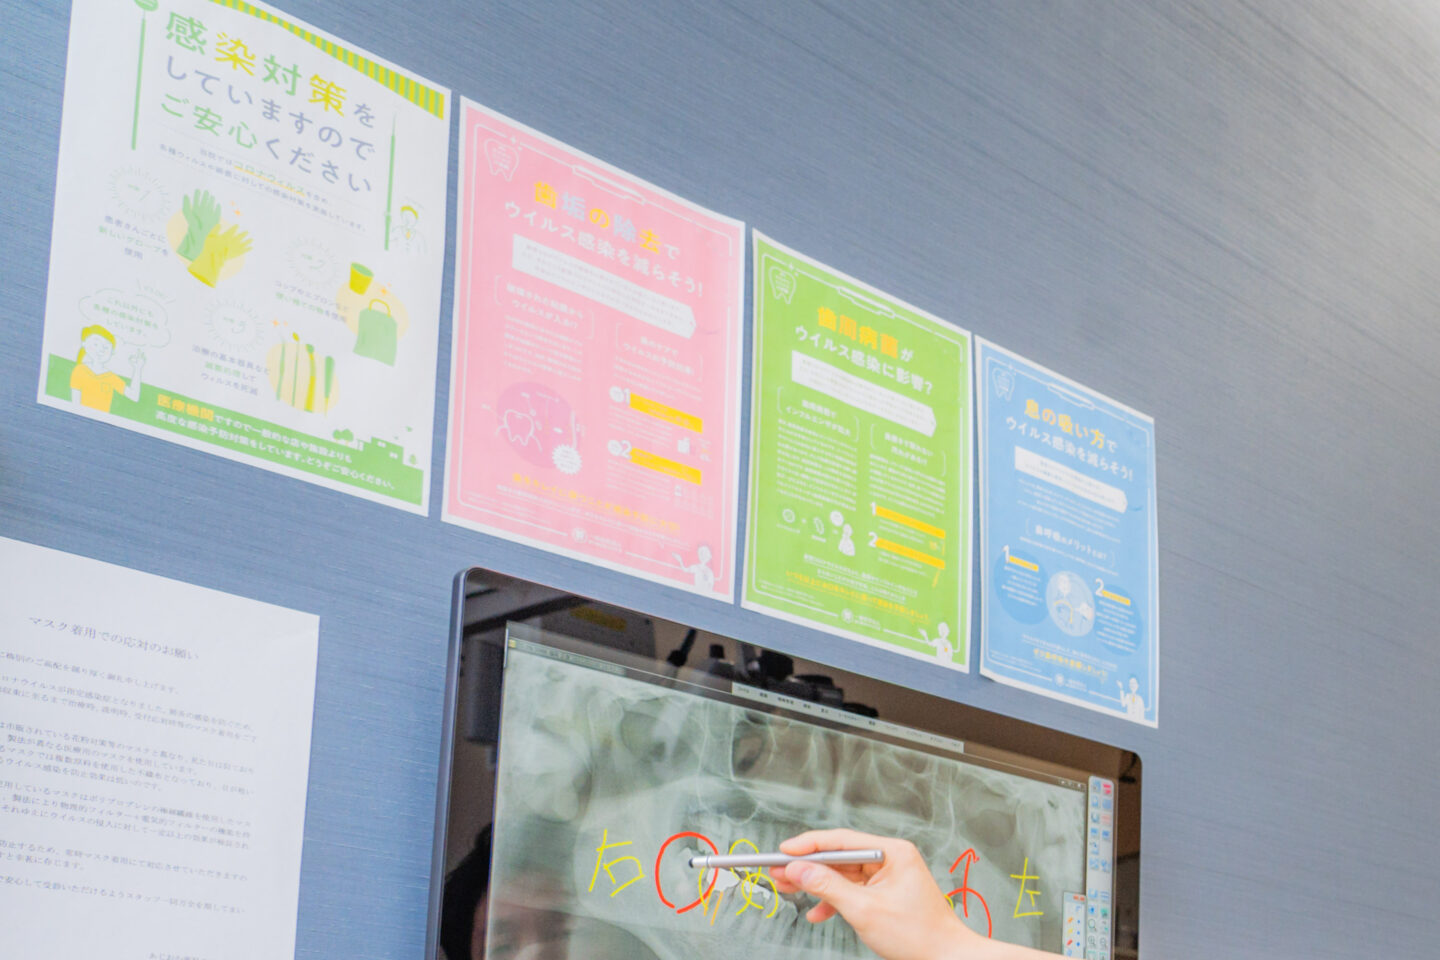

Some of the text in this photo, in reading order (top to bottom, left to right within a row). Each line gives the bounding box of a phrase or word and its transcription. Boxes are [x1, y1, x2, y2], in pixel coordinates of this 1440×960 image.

[166, 11, 375, 128] 感染対策を
[167, 55, 375, 161] していますので
[161, 93, 372, 193] ご安心ください
[534, 181, 680, 259] 歯垢の除去で
[1024, 398, 1117, 453] 息の吸い方で
[588, 828, 645, 897] 右
[1009, 856, 1044, 919] 左
